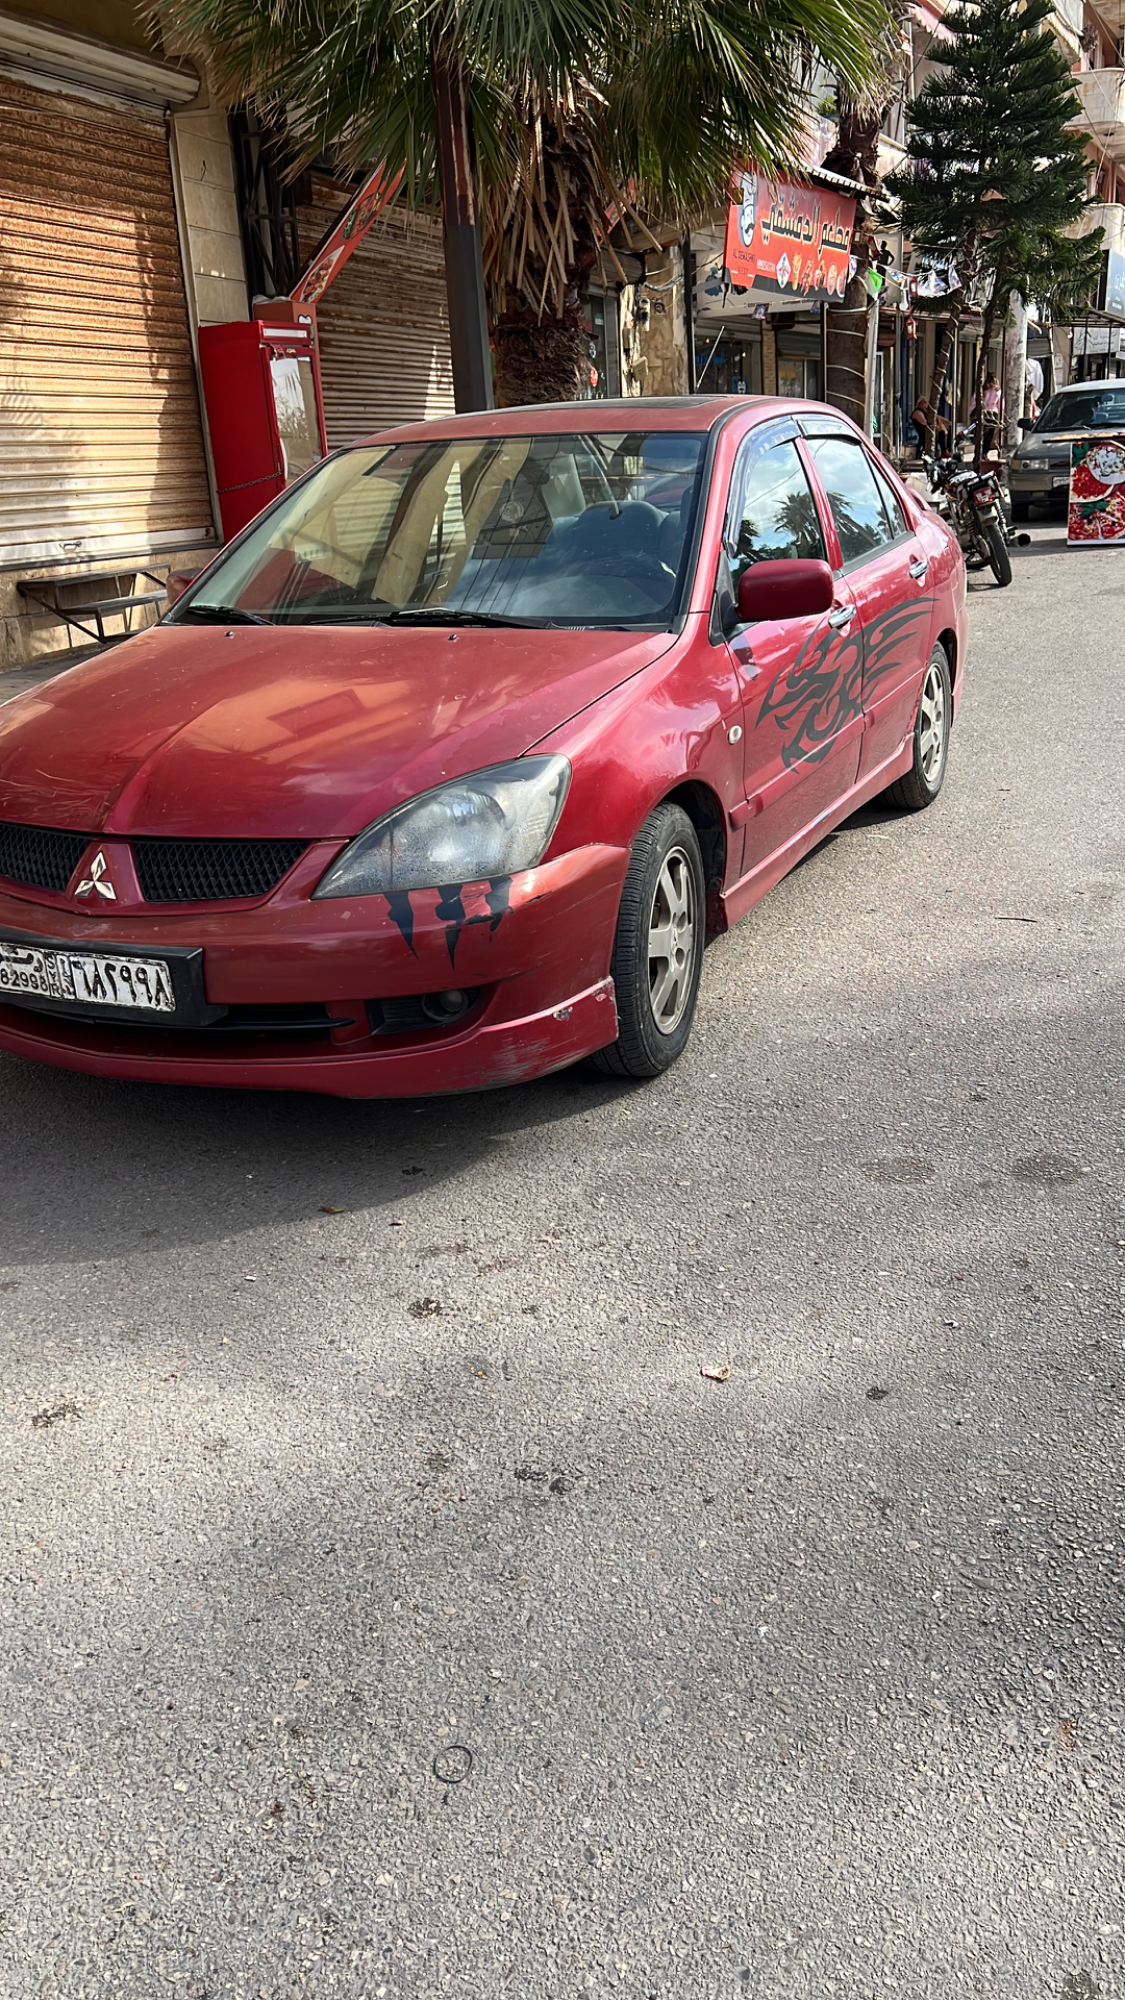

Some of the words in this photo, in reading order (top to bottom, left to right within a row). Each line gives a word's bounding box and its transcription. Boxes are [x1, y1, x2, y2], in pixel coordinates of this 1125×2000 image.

[760, 193, 821, 246] الدمشقي
[818, 207, 850, 260] مطعم
[71, 960, 171, 1007] ٦٨٢٩٩٨
